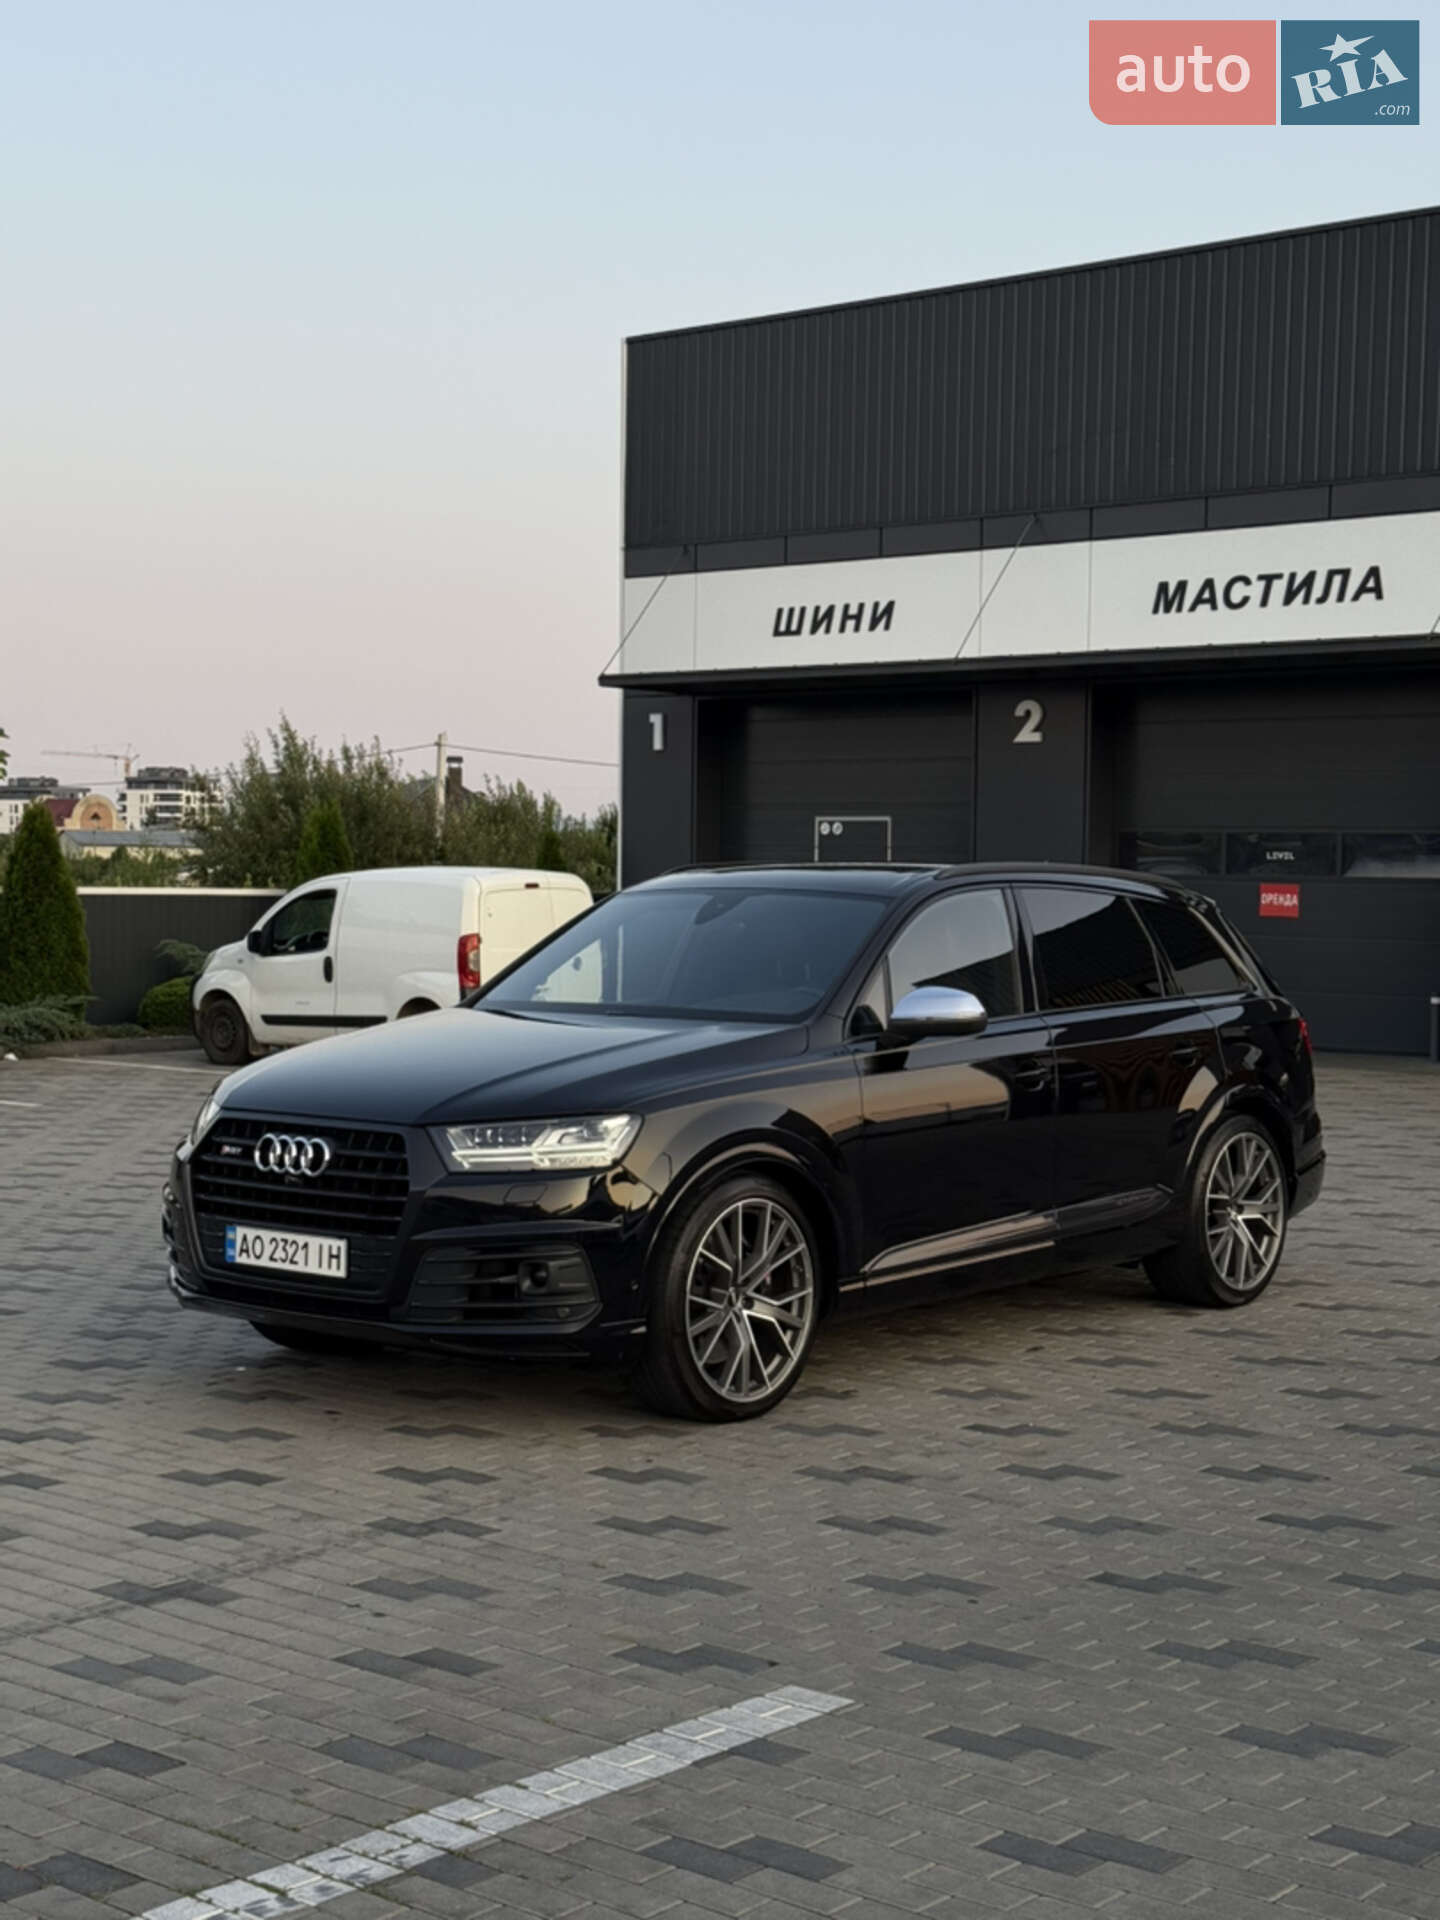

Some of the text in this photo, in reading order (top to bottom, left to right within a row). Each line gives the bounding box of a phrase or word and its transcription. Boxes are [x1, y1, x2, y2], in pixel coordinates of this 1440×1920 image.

[1152, 565, 1384, 615] МАСТИЛА
[772, 600, 896, 637] ШИНИ
[648, 713, 664, 752] 1
[1013, 699, 1044, 744] 2
[1260, 892, 1298, 906] ОРЕНДА
[238, 1233, 342, 1271] AO 2321 IH
